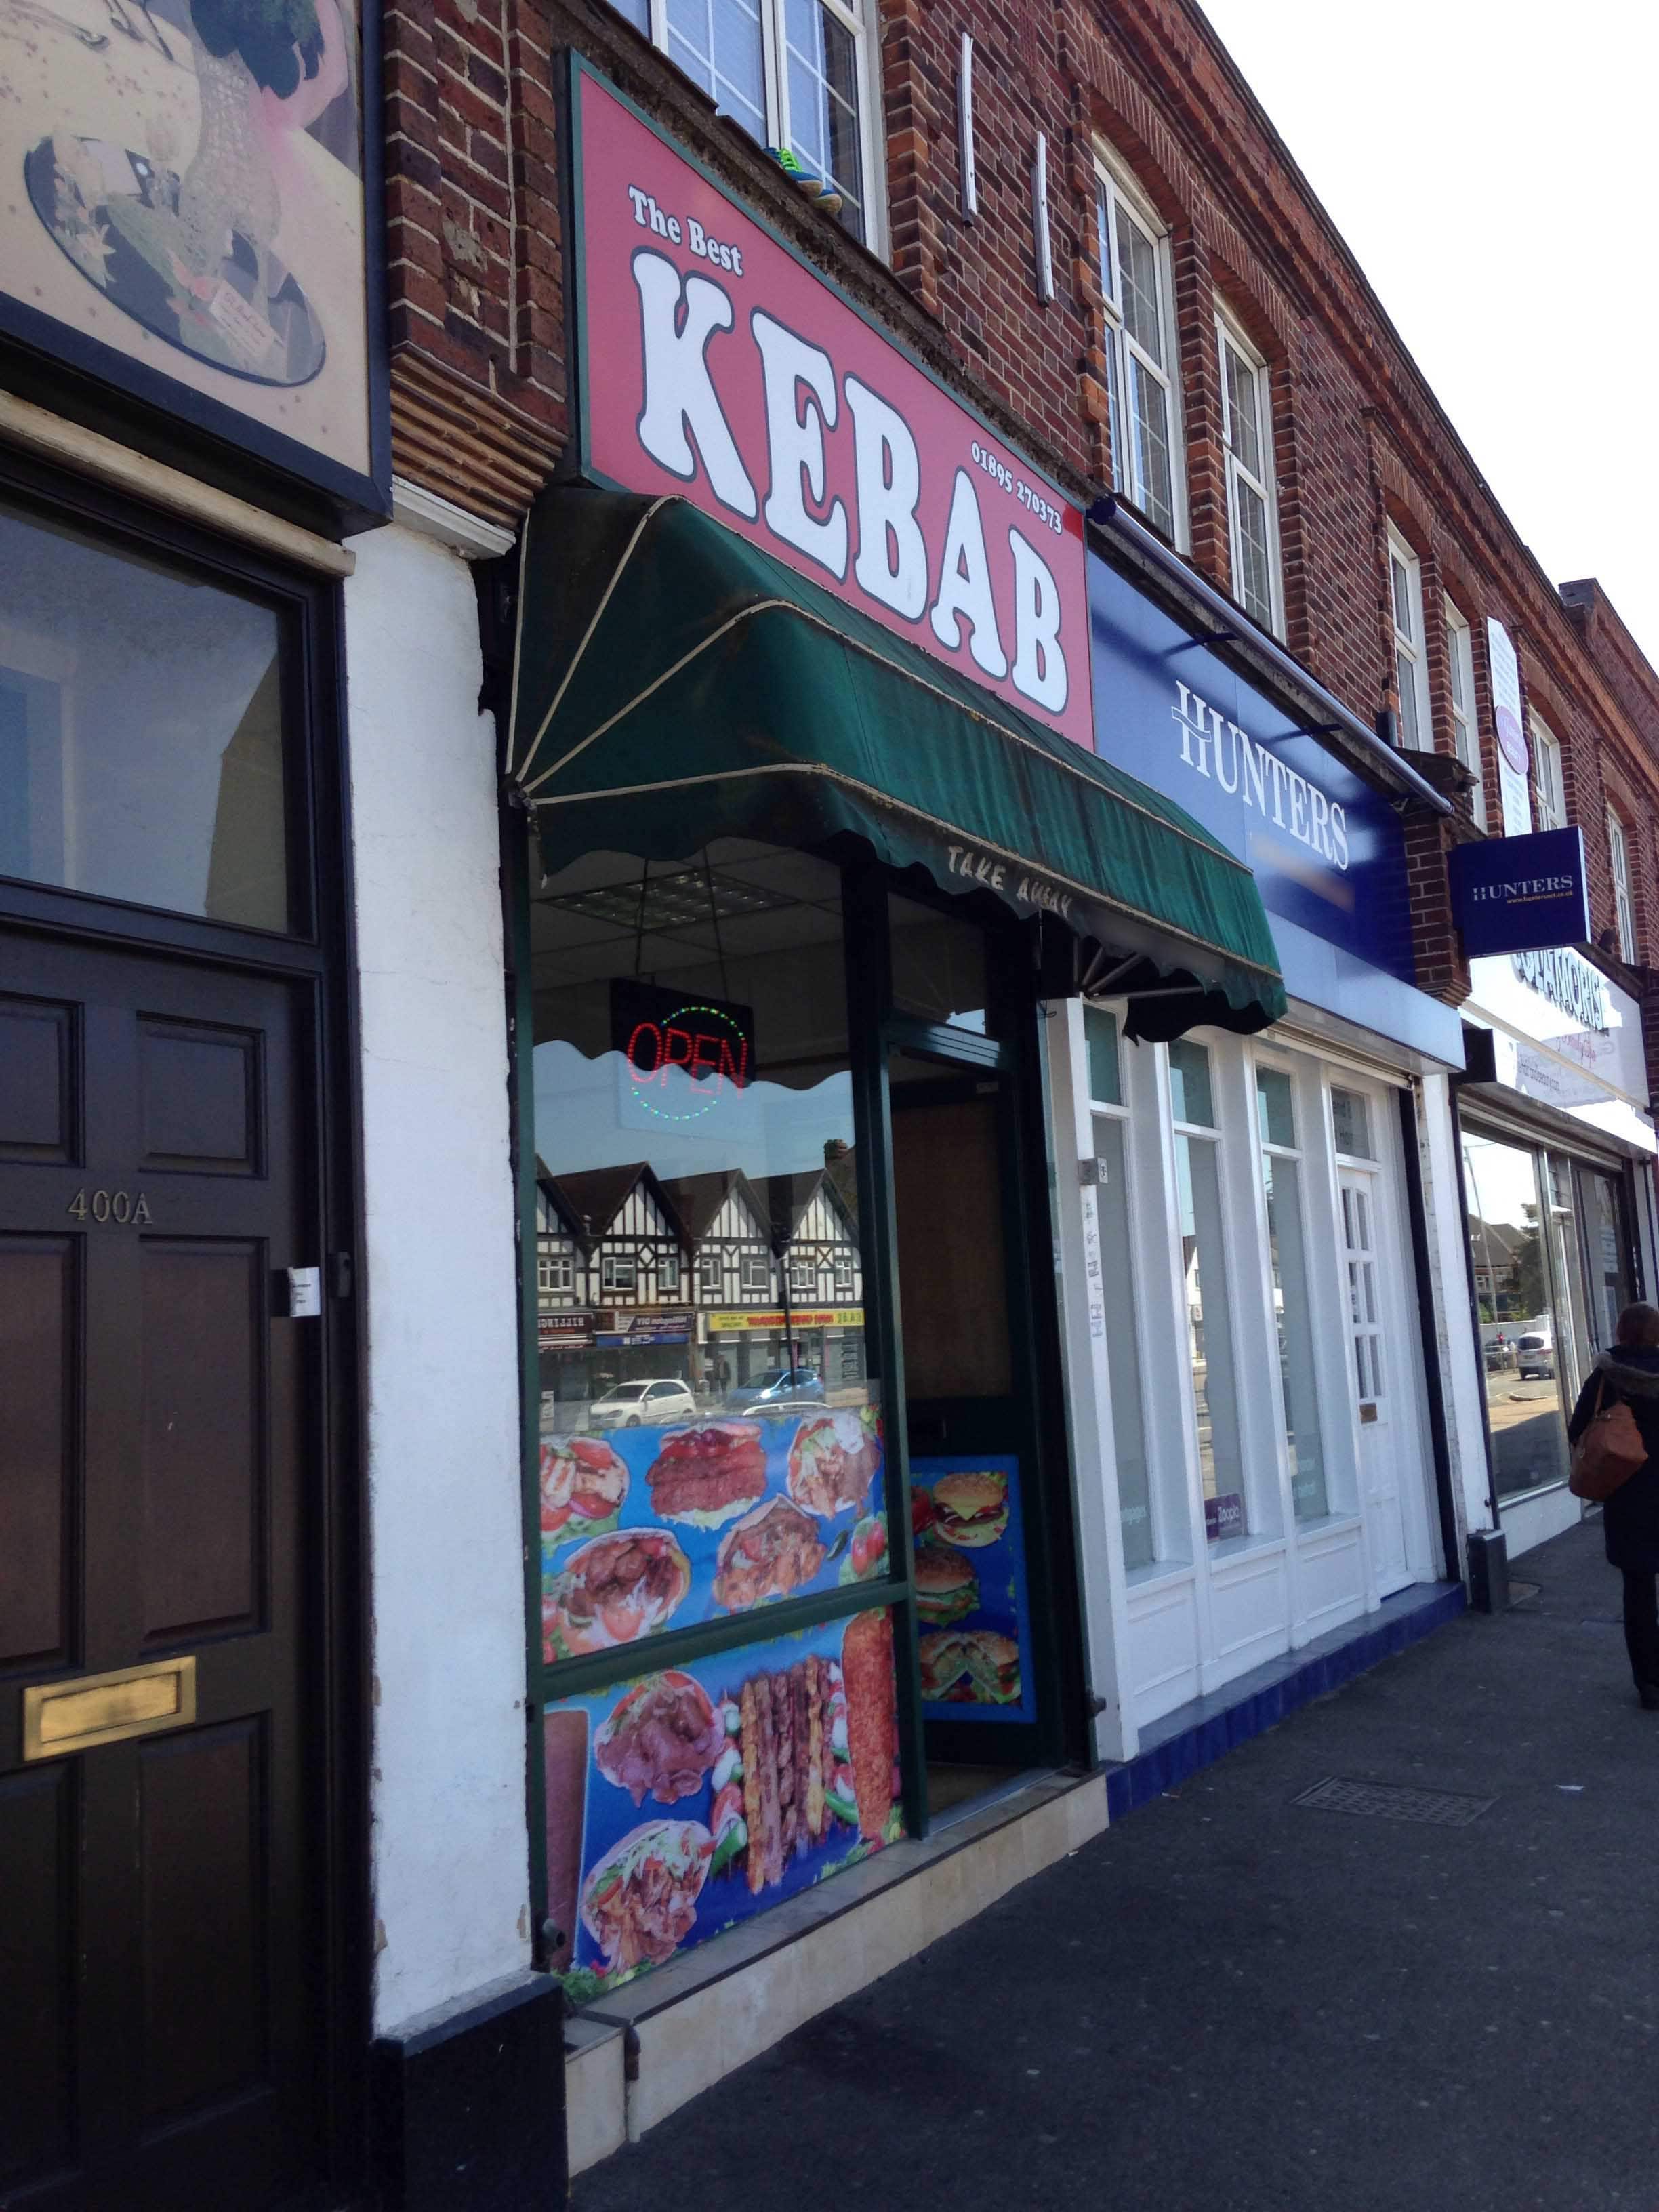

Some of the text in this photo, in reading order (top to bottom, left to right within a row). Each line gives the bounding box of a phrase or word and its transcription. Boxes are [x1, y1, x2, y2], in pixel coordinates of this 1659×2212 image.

[628, 183, 744, 279] The Best
[631, 245, 1069, 716] KEBAB
[971, 440, 1063, 535] 01895 270373
[1171, 680, 1349, 872] HUNTERS
[947, 845, 1006, 891] TAKE
[1473, 874, 1573, 901] HUNTERS
[627, 1021, 749, 1099] OPEN
[67, 1187, 153, 1224] 400A
